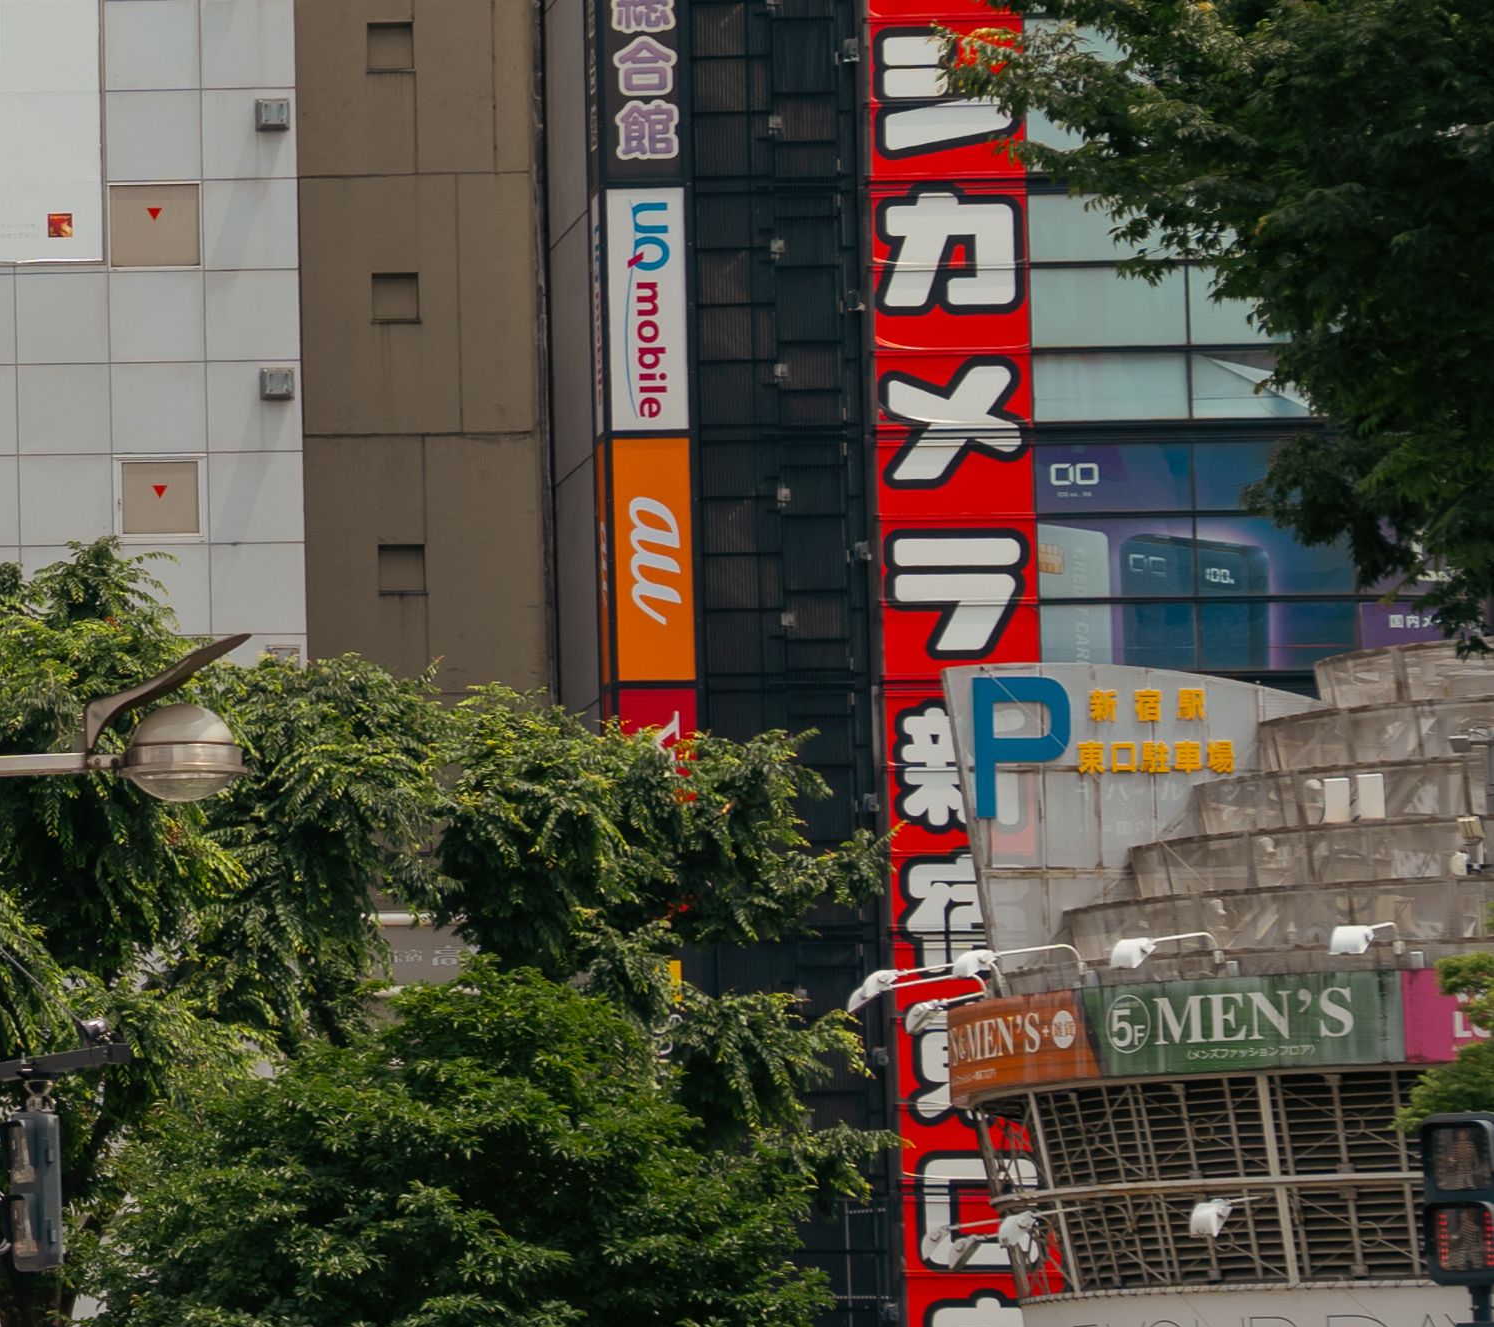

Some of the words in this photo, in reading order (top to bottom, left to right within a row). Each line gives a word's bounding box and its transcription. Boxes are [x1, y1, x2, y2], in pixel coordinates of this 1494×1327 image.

[627, 200, 670, 272] UQ
[636, 281, 670, 419] mobile
[628, 497, 683, 625] au
[972, 676, 1071, 819] P
[1090, 688, 1207, 722] 新宿駅
[1077, 740, 1235, 774] 東口駐車場
